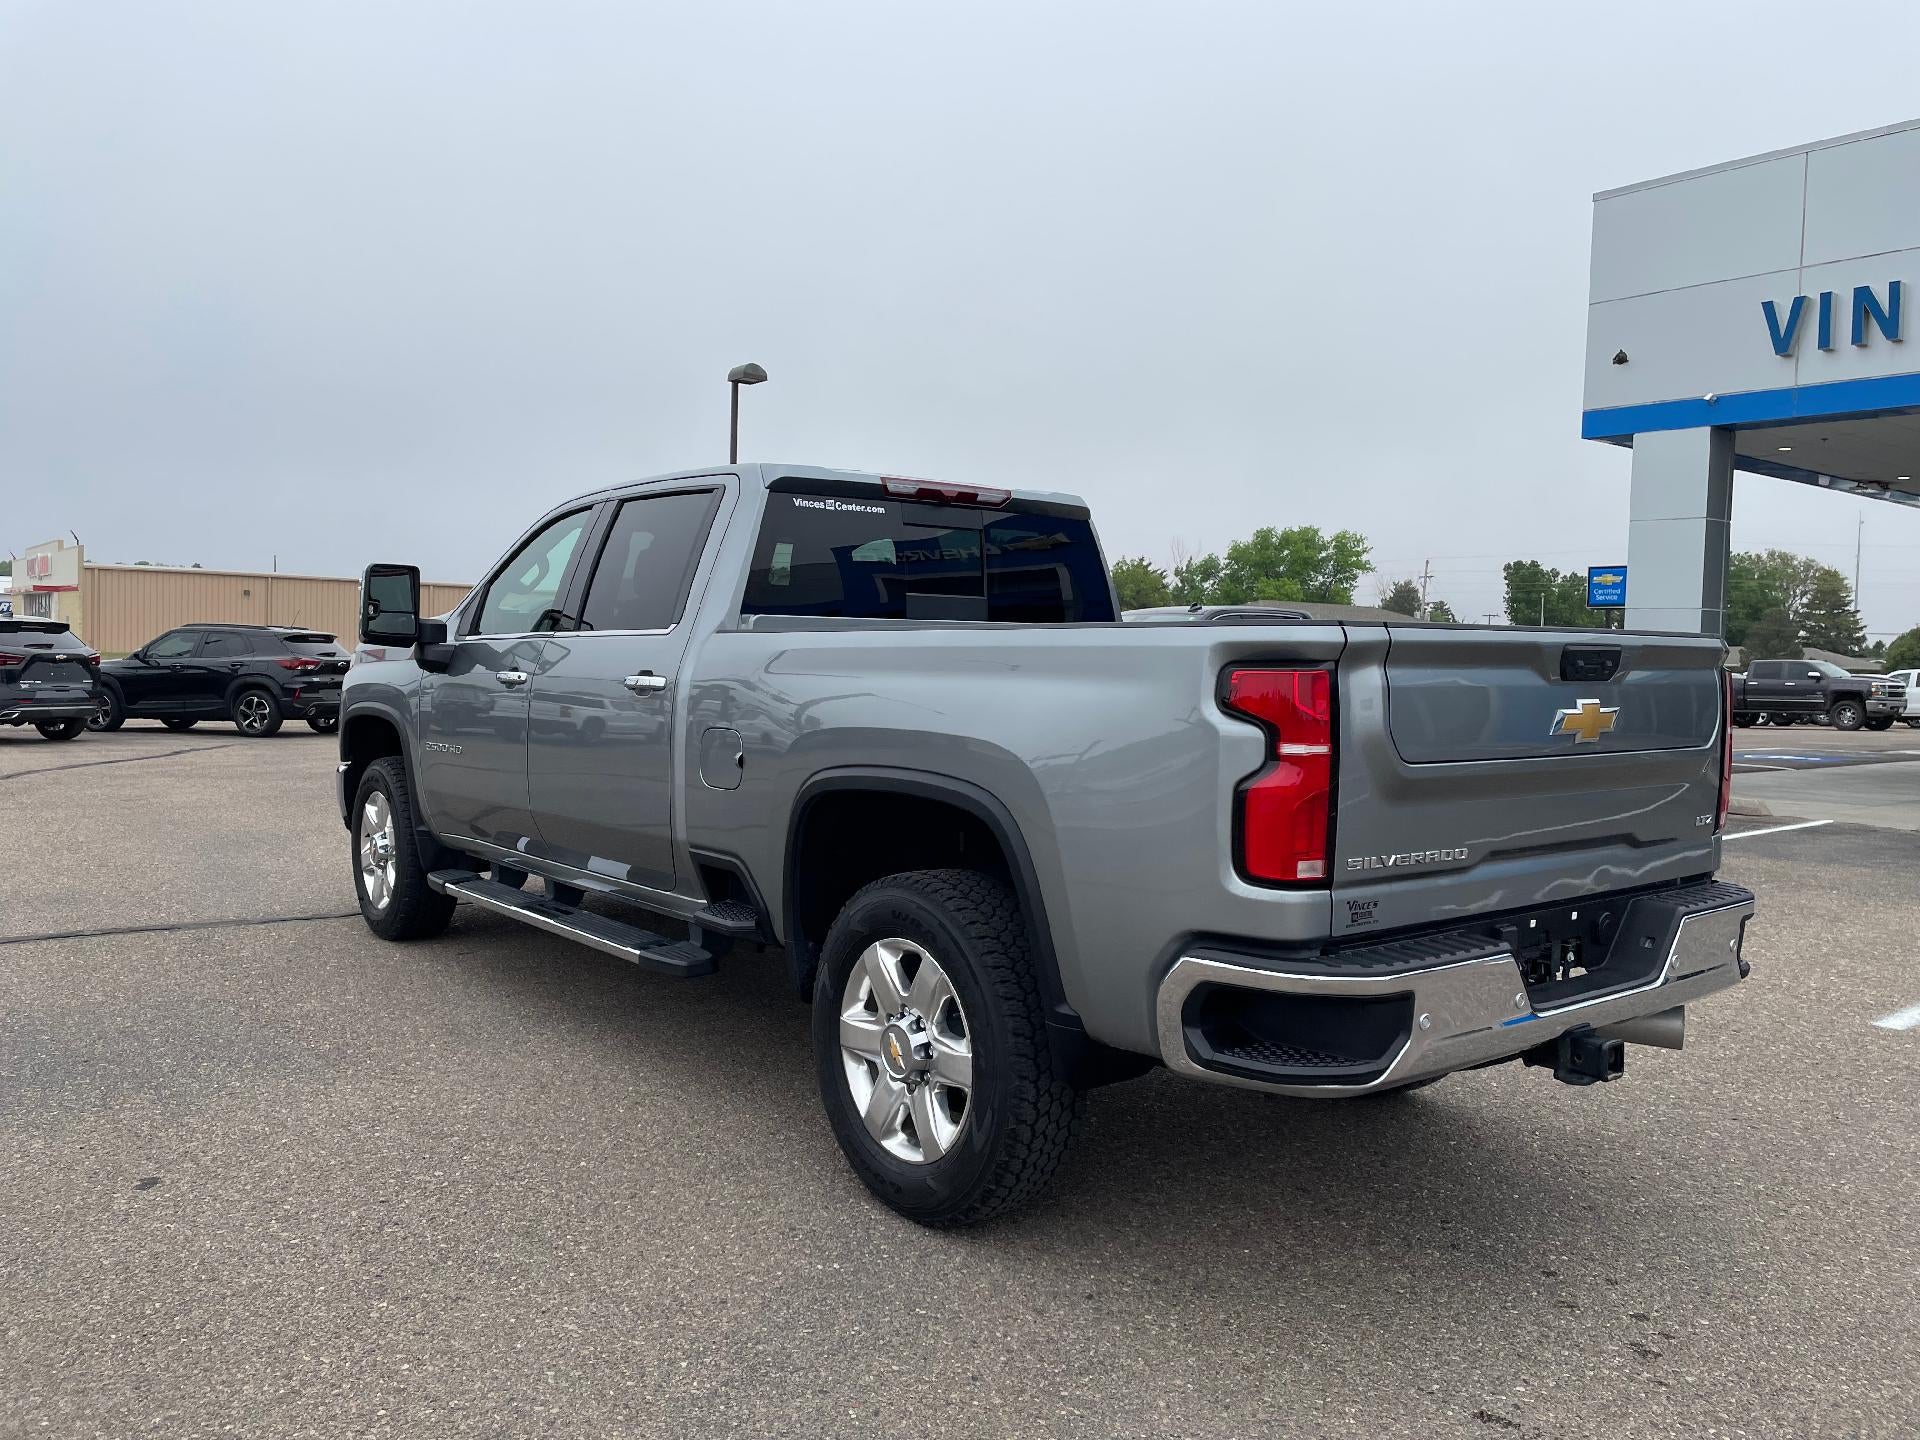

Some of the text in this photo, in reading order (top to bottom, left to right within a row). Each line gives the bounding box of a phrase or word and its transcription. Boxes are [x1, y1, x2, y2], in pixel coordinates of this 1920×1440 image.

[1761, 280, 1904, 357] VIN
[425, 741, 462, 754] 2500 HD
[1695, 814, 1712, 827] LTZ
[1346, 848, 1469, 870] SILVERADO
